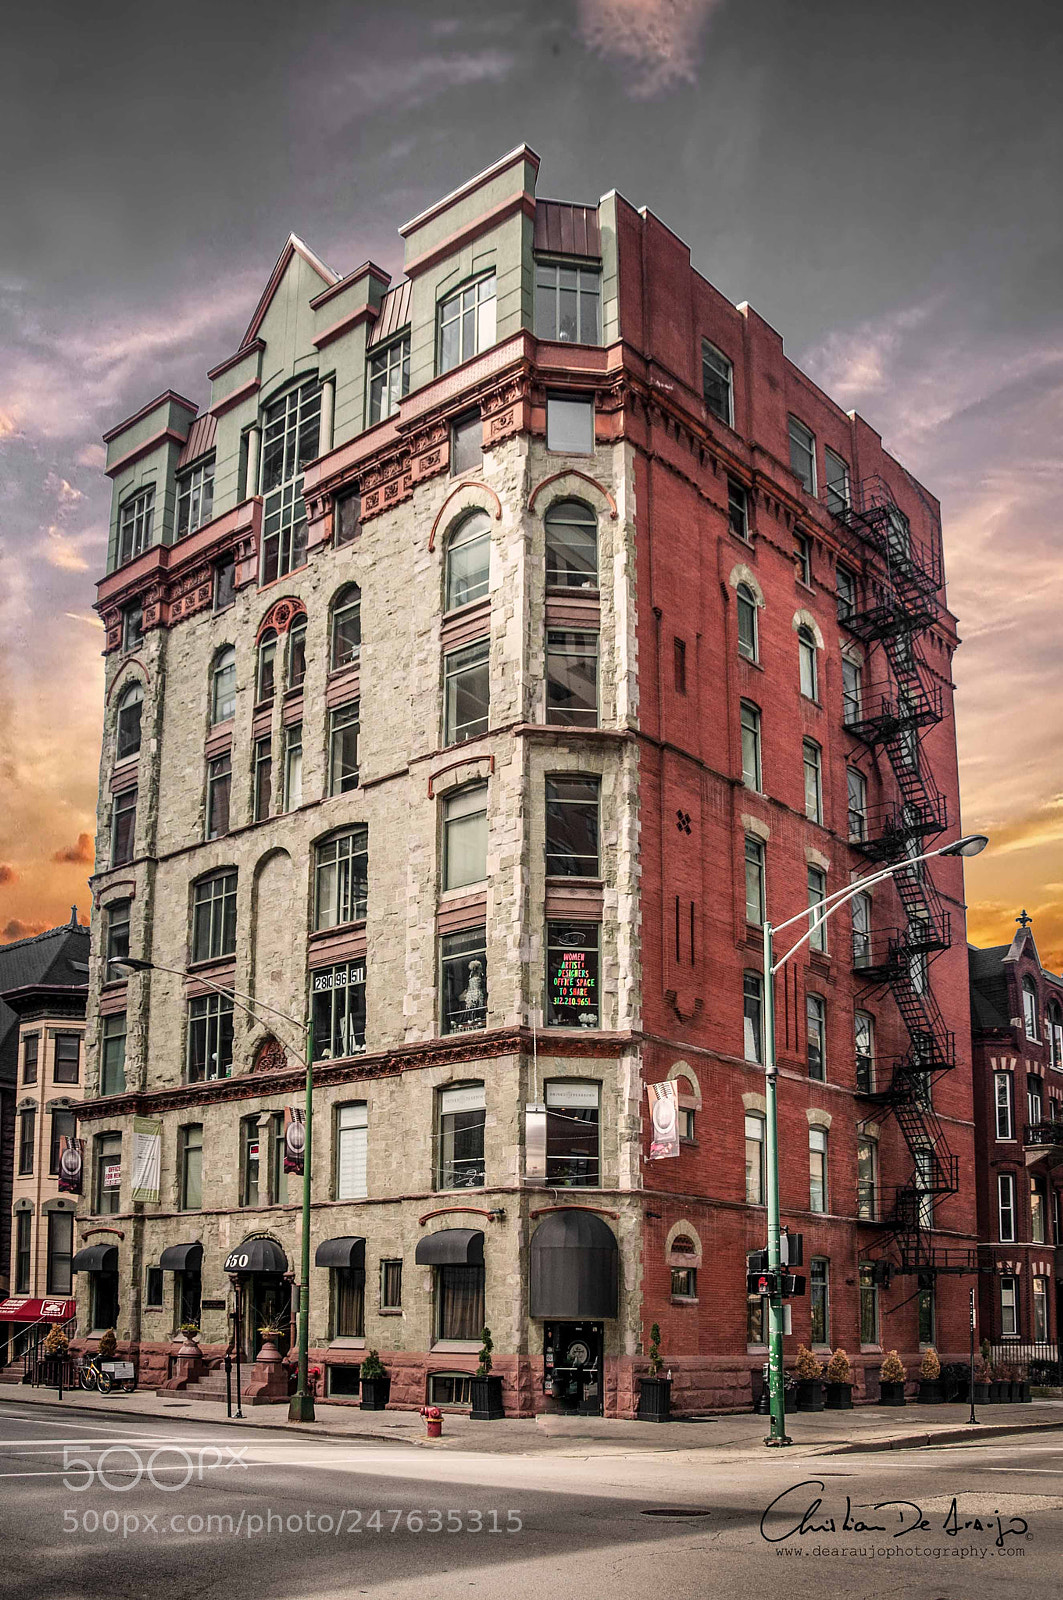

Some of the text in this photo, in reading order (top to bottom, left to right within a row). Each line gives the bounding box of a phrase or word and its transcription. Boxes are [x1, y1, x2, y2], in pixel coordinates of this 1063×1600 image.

[563, 953, 585, 961] WOMEN
[558, 970, 589, 978] DESIGNERS
[553, 977, 595, 987] OFFICE SPACE
[559, 987, 588, 996] TO SHARE
